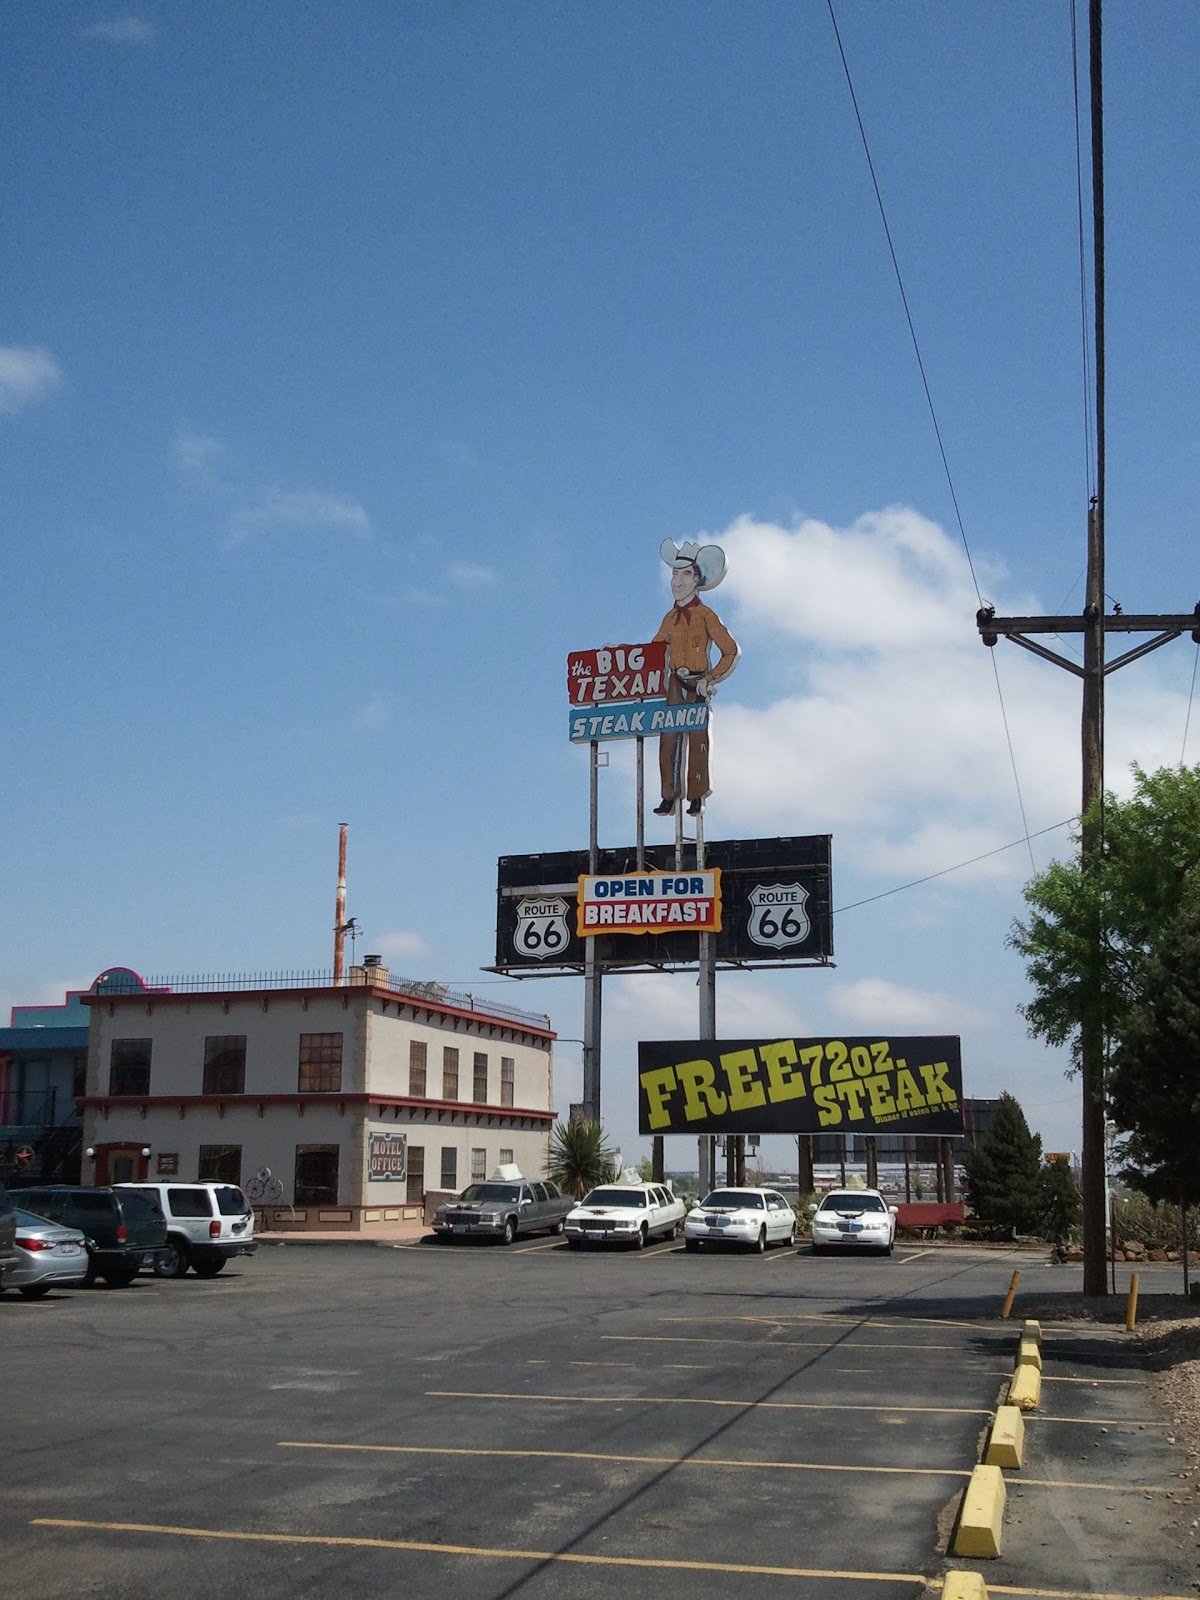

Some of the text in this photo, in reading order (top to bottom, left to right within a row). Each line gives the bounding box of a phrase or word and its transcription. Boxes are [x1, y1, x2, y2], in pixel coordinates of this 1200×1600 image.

[571, 648, 645, 677] the BIG
[576, 670, 661, 702] TEXAN
[571, 706, 707, 739] STEAK RANCH
[594, 877, 704, 898] OPEN FOR
[758, 891, 798, 903] ROUTE
[524, 904, 559, 916] ROUTE
[584, 901, 711, 925] BREAKFAST
[759, 907, 801, 938] 66
[523, 920, 562, 949] 66
[640, 1039, 807, 1130] FREE
[813, 1061, 957, 1127] STEAK
[874, 1113, 900, 1124] Dinner
[901, 1111, 908, 1119] if
[909, 1107, 930, 1117] eaten
[931, 1105, 940, 1113] in
[373, 1141, 401, 1155] MOTEL
[371, 1157, 402, 1171] OFFICE
